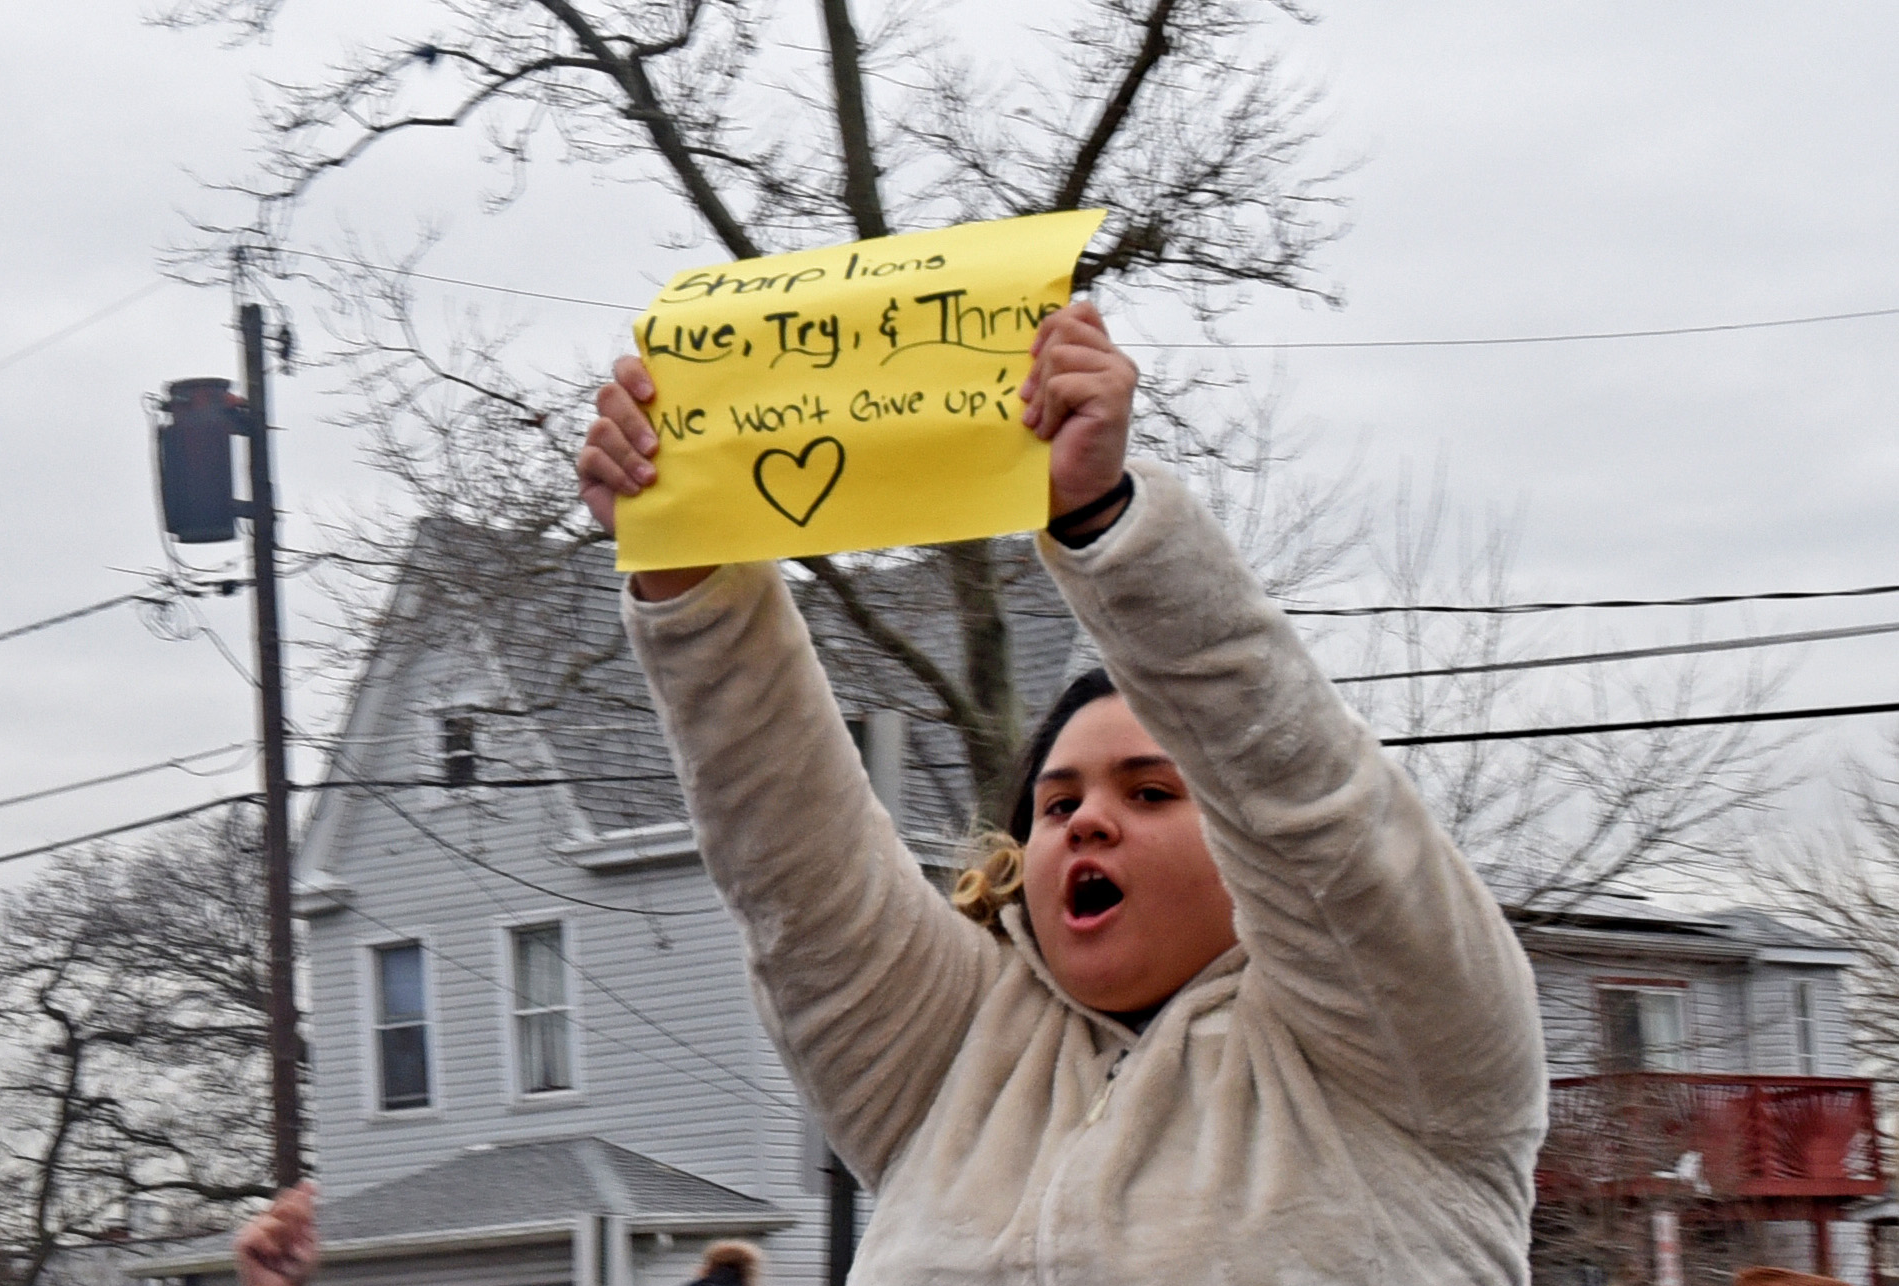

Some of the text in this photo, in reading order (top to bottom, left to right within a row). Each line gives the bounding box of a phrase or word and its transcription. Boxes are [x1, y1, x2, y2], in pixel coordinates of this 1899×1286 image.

[660, 266, 826, 304] Sharp
[644, 316, 753, 357] Live,
[764, 311, 861, 368] Try,
[878, 297, 901, 349] &
[849, 389, 925, 424] Give
